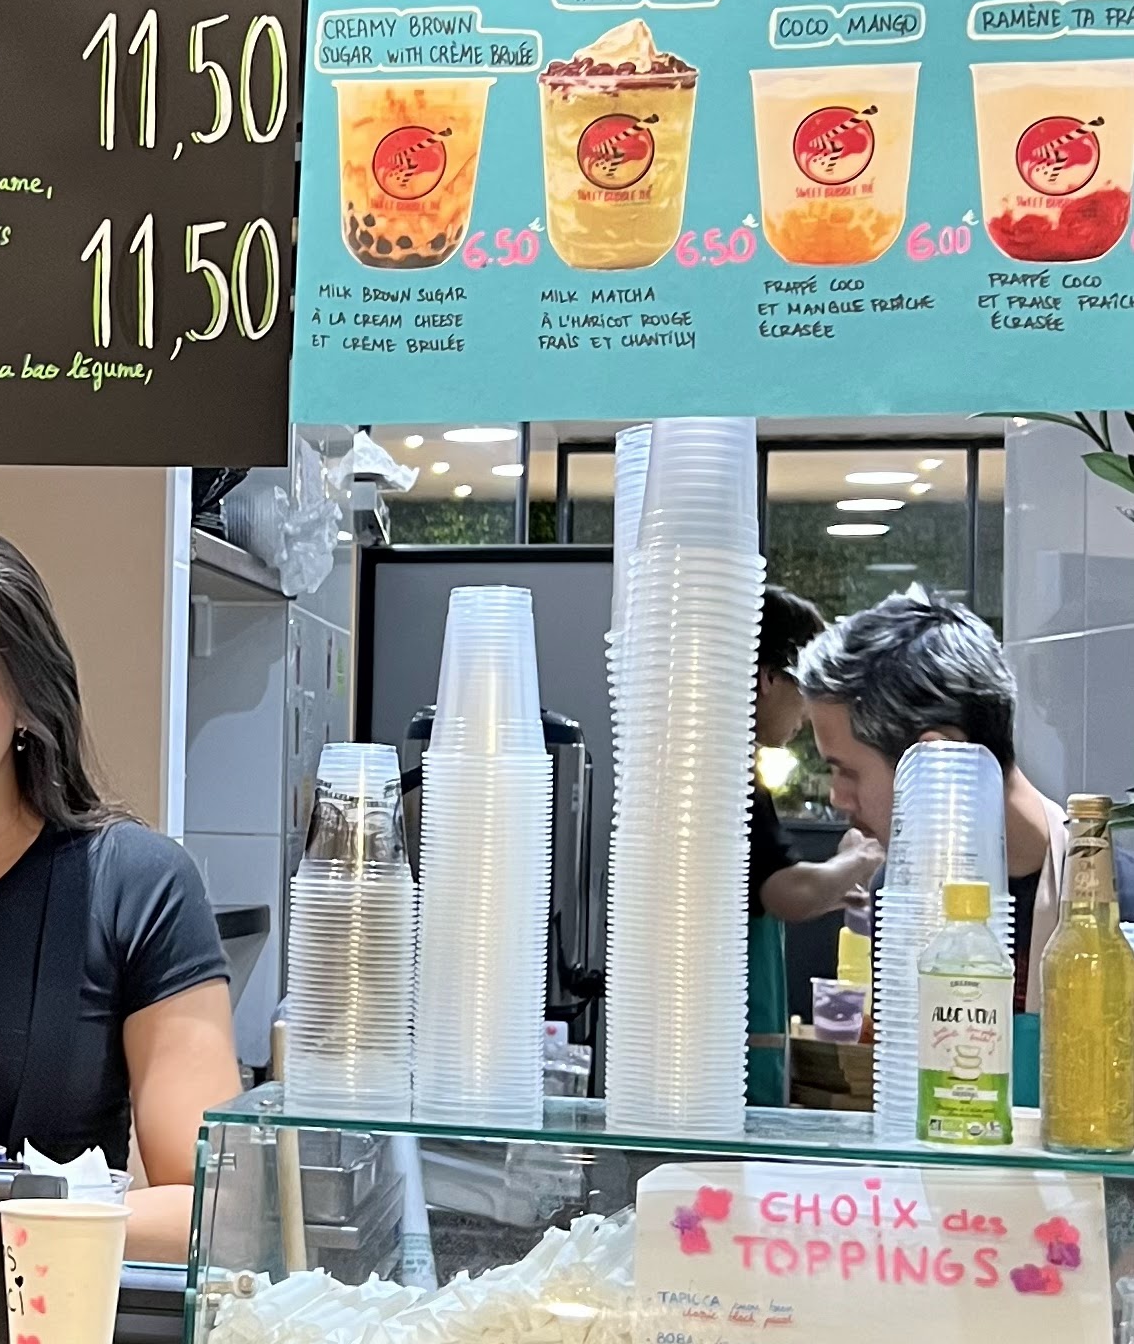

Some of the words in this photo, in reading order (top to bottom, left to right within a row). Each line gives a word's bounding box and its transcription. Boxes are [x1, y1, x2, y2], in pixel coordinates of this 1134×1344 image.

[323, 18, 397, 39] CREAMY
[409, 13, 473, 37] BROWN
[779, 17, 828, 38] COCO
[847, 13, 917, 35] MANGO
[982, 4, 1061, 31] RAMÈNE
[1072, 8, 1095, 26] TA
[321, 46, 373, 66] SUGAR
[429, 40, 483, 65] CRÈME
[82, 9, 288, 160] 11,50
[463, 228, 540, 270] 6.50
[676, 227, 757, 268] 6.50
[907, 222, 971, 262] 6.00
[80, 213, 280, 360] 11,50
[763, 275, 817, 295] FRAPPÉ
[829, 279, 865, 292] COCO
[988, 269, 1050, 288] FRAPPÉ
[1062, 274, 1102, 289] COCO
[362, 287, 411, 302] BROWN
[417, 287, 467, 304] SUGAR
[591, 286, 656, 304] MATCHA
[758, 303, 780, 316] ET
[787, 299, 866, 315] MANGUE
[329, 312, 346, 325] LA
[354, 313, 402, 327] CREAM
[414, 313, 464, 327] CHEESE
[641, 311, 692, 327] ROUGE
[758, 320, 836, 338] ÉCRASÉE
[312, 334, 330, 348] ET
[406, 334, 465, 353] BRULÉE
[590, 337, 612, 349] ET
[21, 354, 60, 379] bao
[943, 1209, 1008, 1236] des
